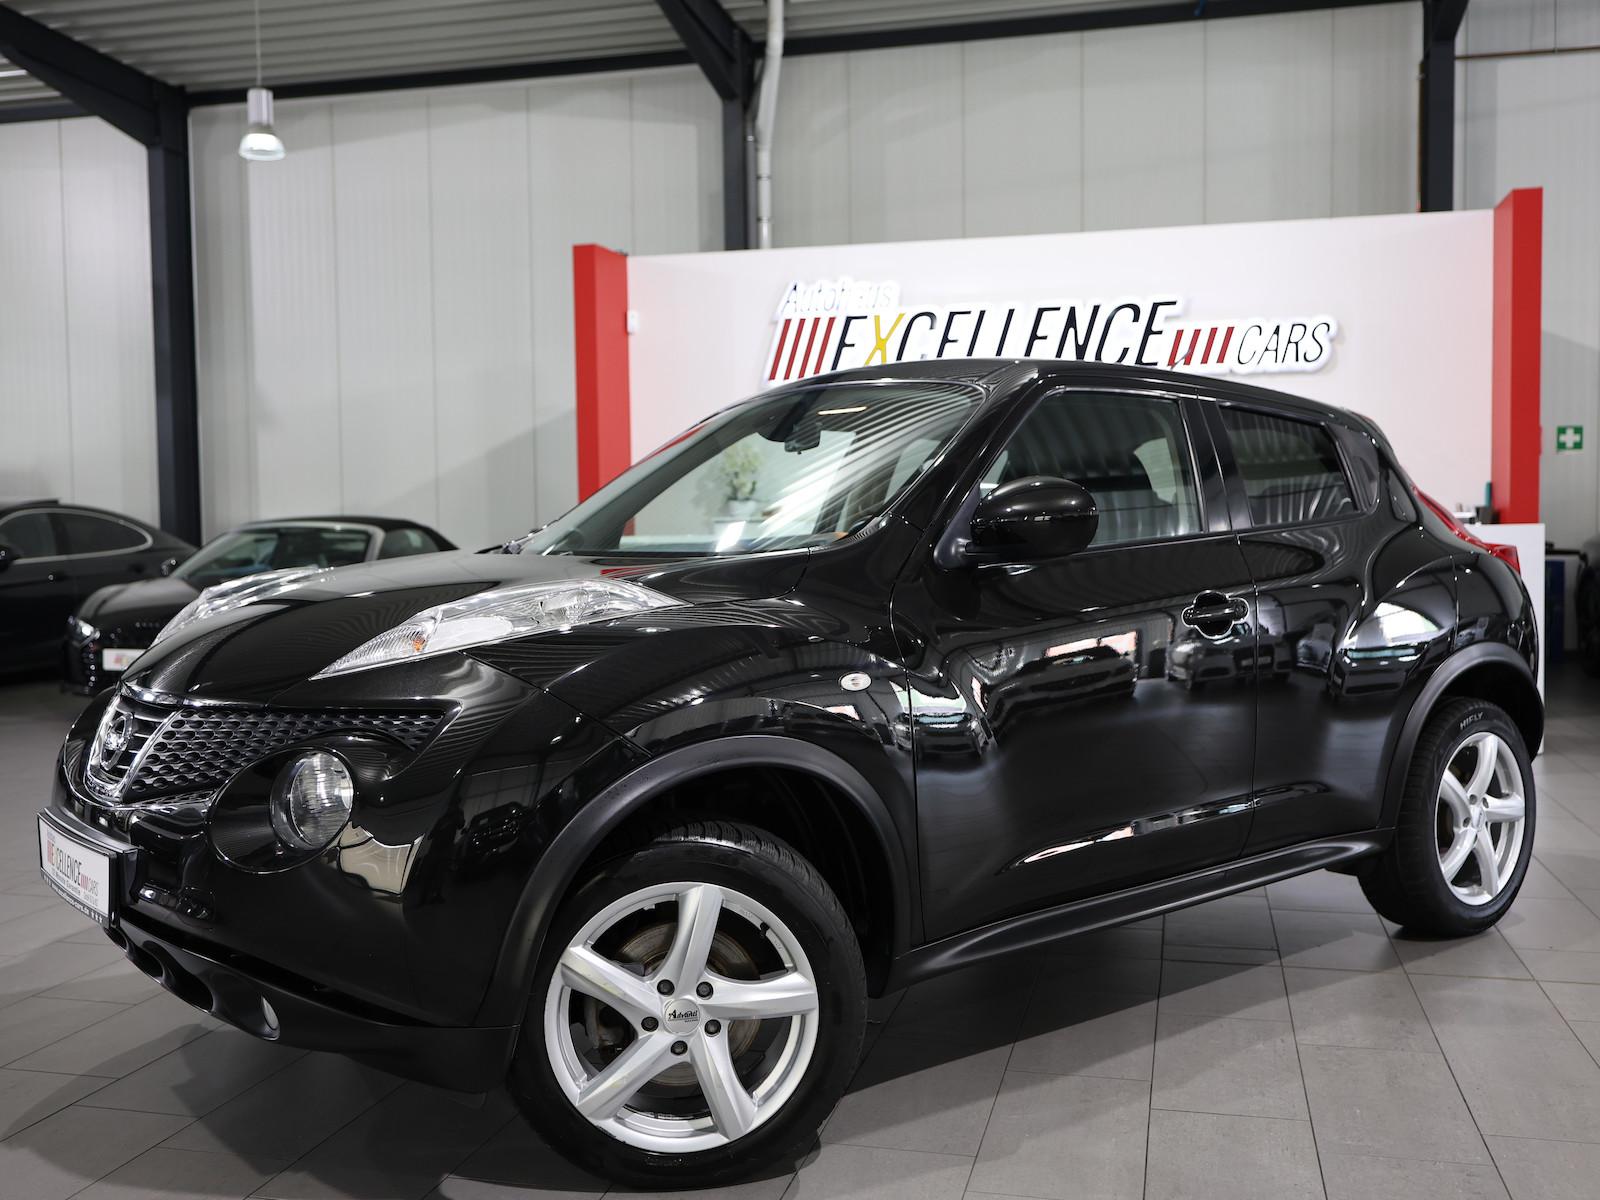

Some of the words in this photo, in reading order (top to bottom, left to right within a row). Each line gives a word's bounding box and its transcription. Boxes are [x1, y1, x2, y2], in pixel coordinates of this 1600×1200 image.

[780, 281, 892, 312] Autohus
[1237, 322, 1331, 365] CARS
[1460, 711, 1483, 730] HIFLY
